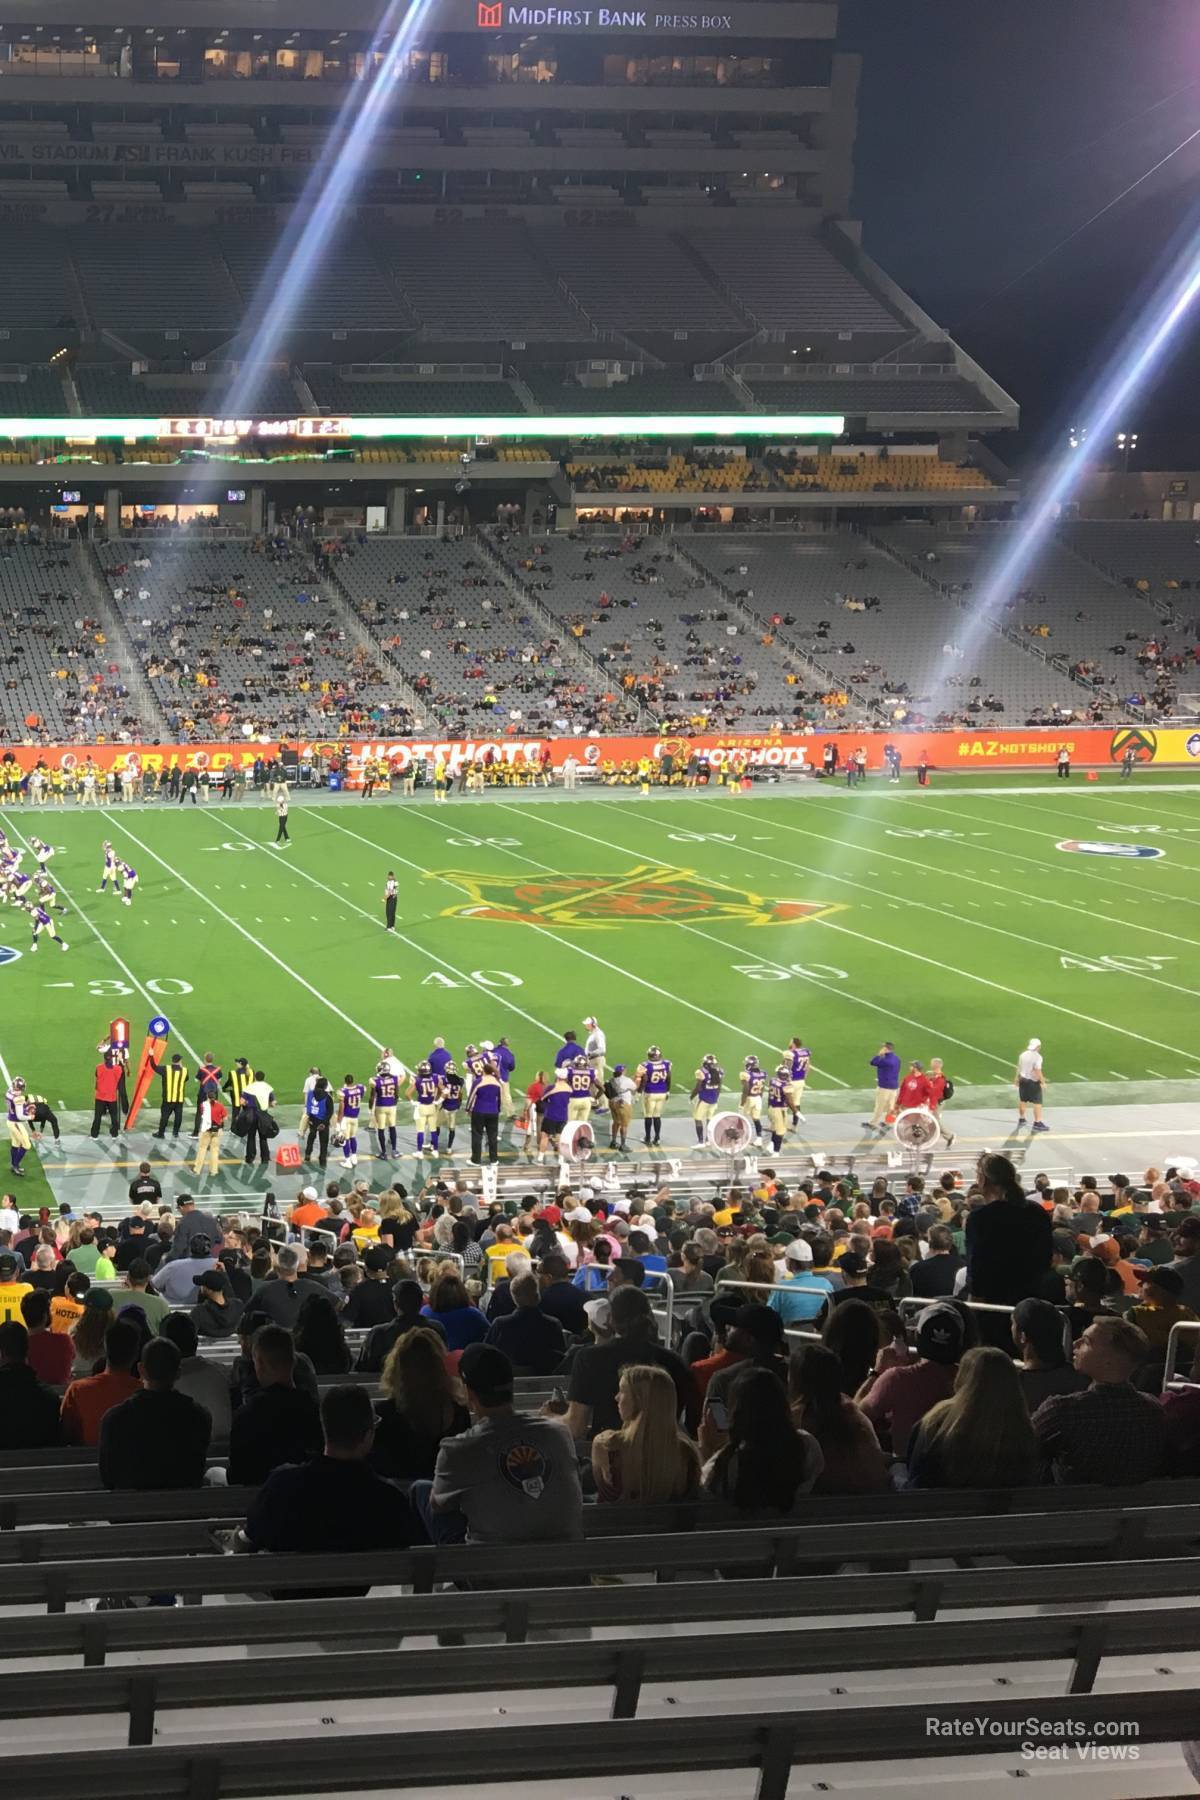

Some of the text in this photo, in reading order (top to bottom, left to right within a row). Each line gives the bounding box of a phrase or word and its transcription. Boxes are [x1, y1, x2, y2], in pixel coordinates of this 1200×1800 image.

[656, 14, 698, 28] PRESS
[702, 15, 732, 29] BOX
[31, 145, 110, 160] STADIUM
[155, 146, 217, 162] FRANK
[223, 147, 272, 162] KUSH
[716, 738, 783, 747] ARIZONA
[731, 962, 849, 981] 50
[88, 978, 194, 997] 30
[115, 1021, 125, 1041] 1
[572, 1075, 591, 1091] 89
[284, 1147, 298, 1163] 30
